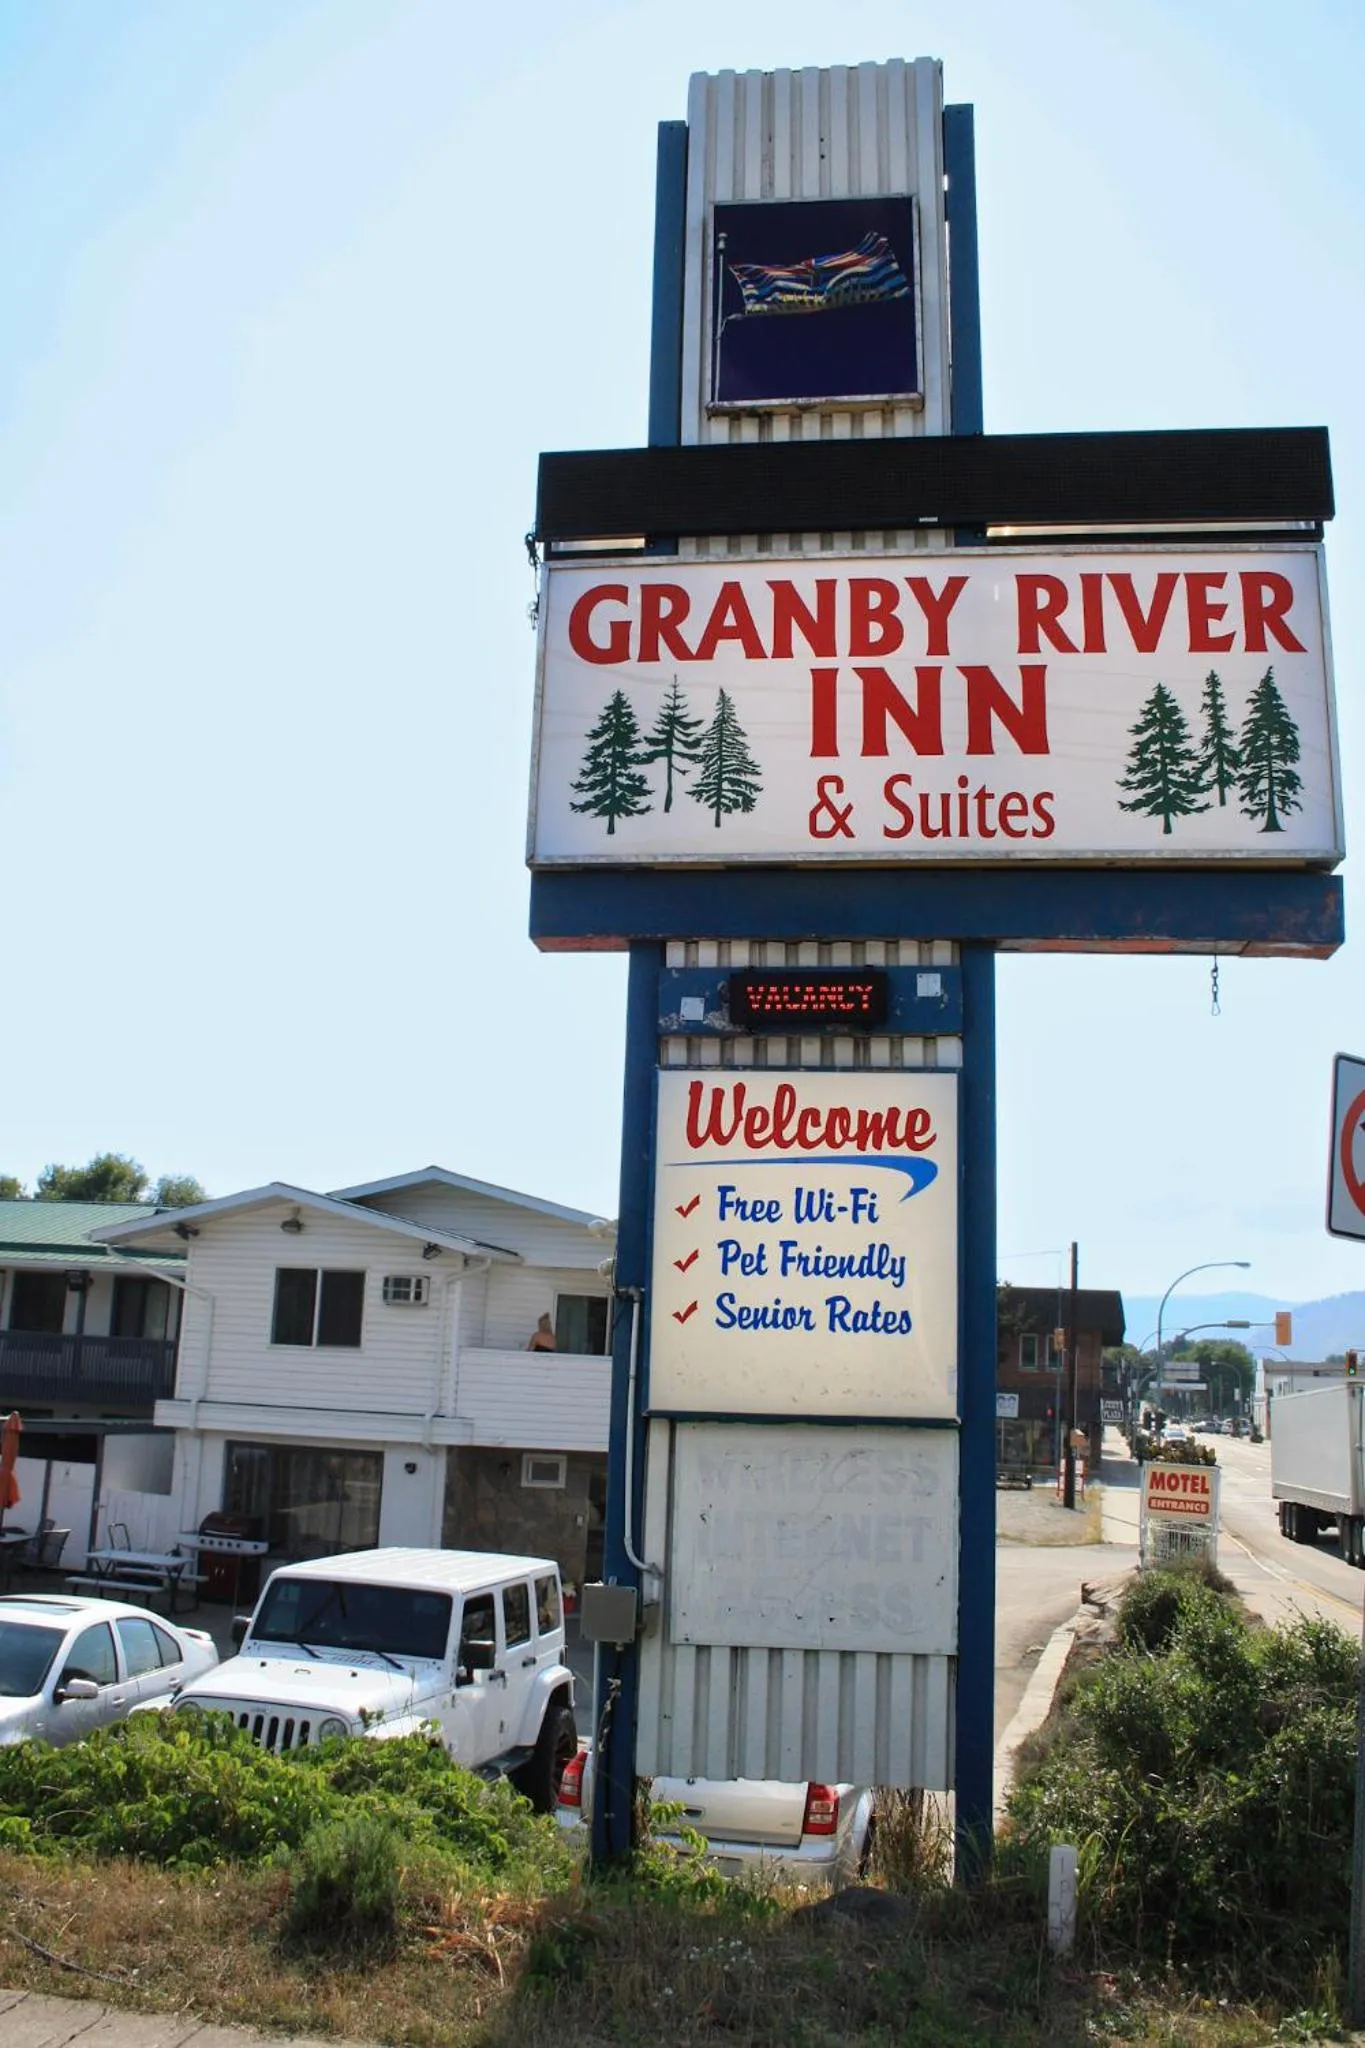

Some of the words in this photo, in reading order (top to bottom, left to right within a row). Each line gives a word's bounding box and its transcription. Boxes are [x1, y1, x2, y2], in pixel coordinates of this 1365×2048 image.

[568, 576, 969, 665] GRANBY
[1014, 571, 1306, 655] RIVER
[810, 664, 1050, 758] INN
[809, 774, 854, 840] &
[882, 773, 1055, 840] Suites
[746, 984, 874, 1012] VACANCY
[686, 1081, 937, 1152] Welcome
[717, 1185, 782, 1223] Free
[794, 1186, 879, 1224] Wi-Fi
[717, 1239, 768, 1277] Pet
[779, 1240, 906, 1288] Friendly
[715, 1293, 816, 1332] Senior
[825, 1295, 913, 1335] Rates
[1149, 1471, 1210, 1495] MOTEL
[1150, 1498, 1207, 1513] ENTRANCE
